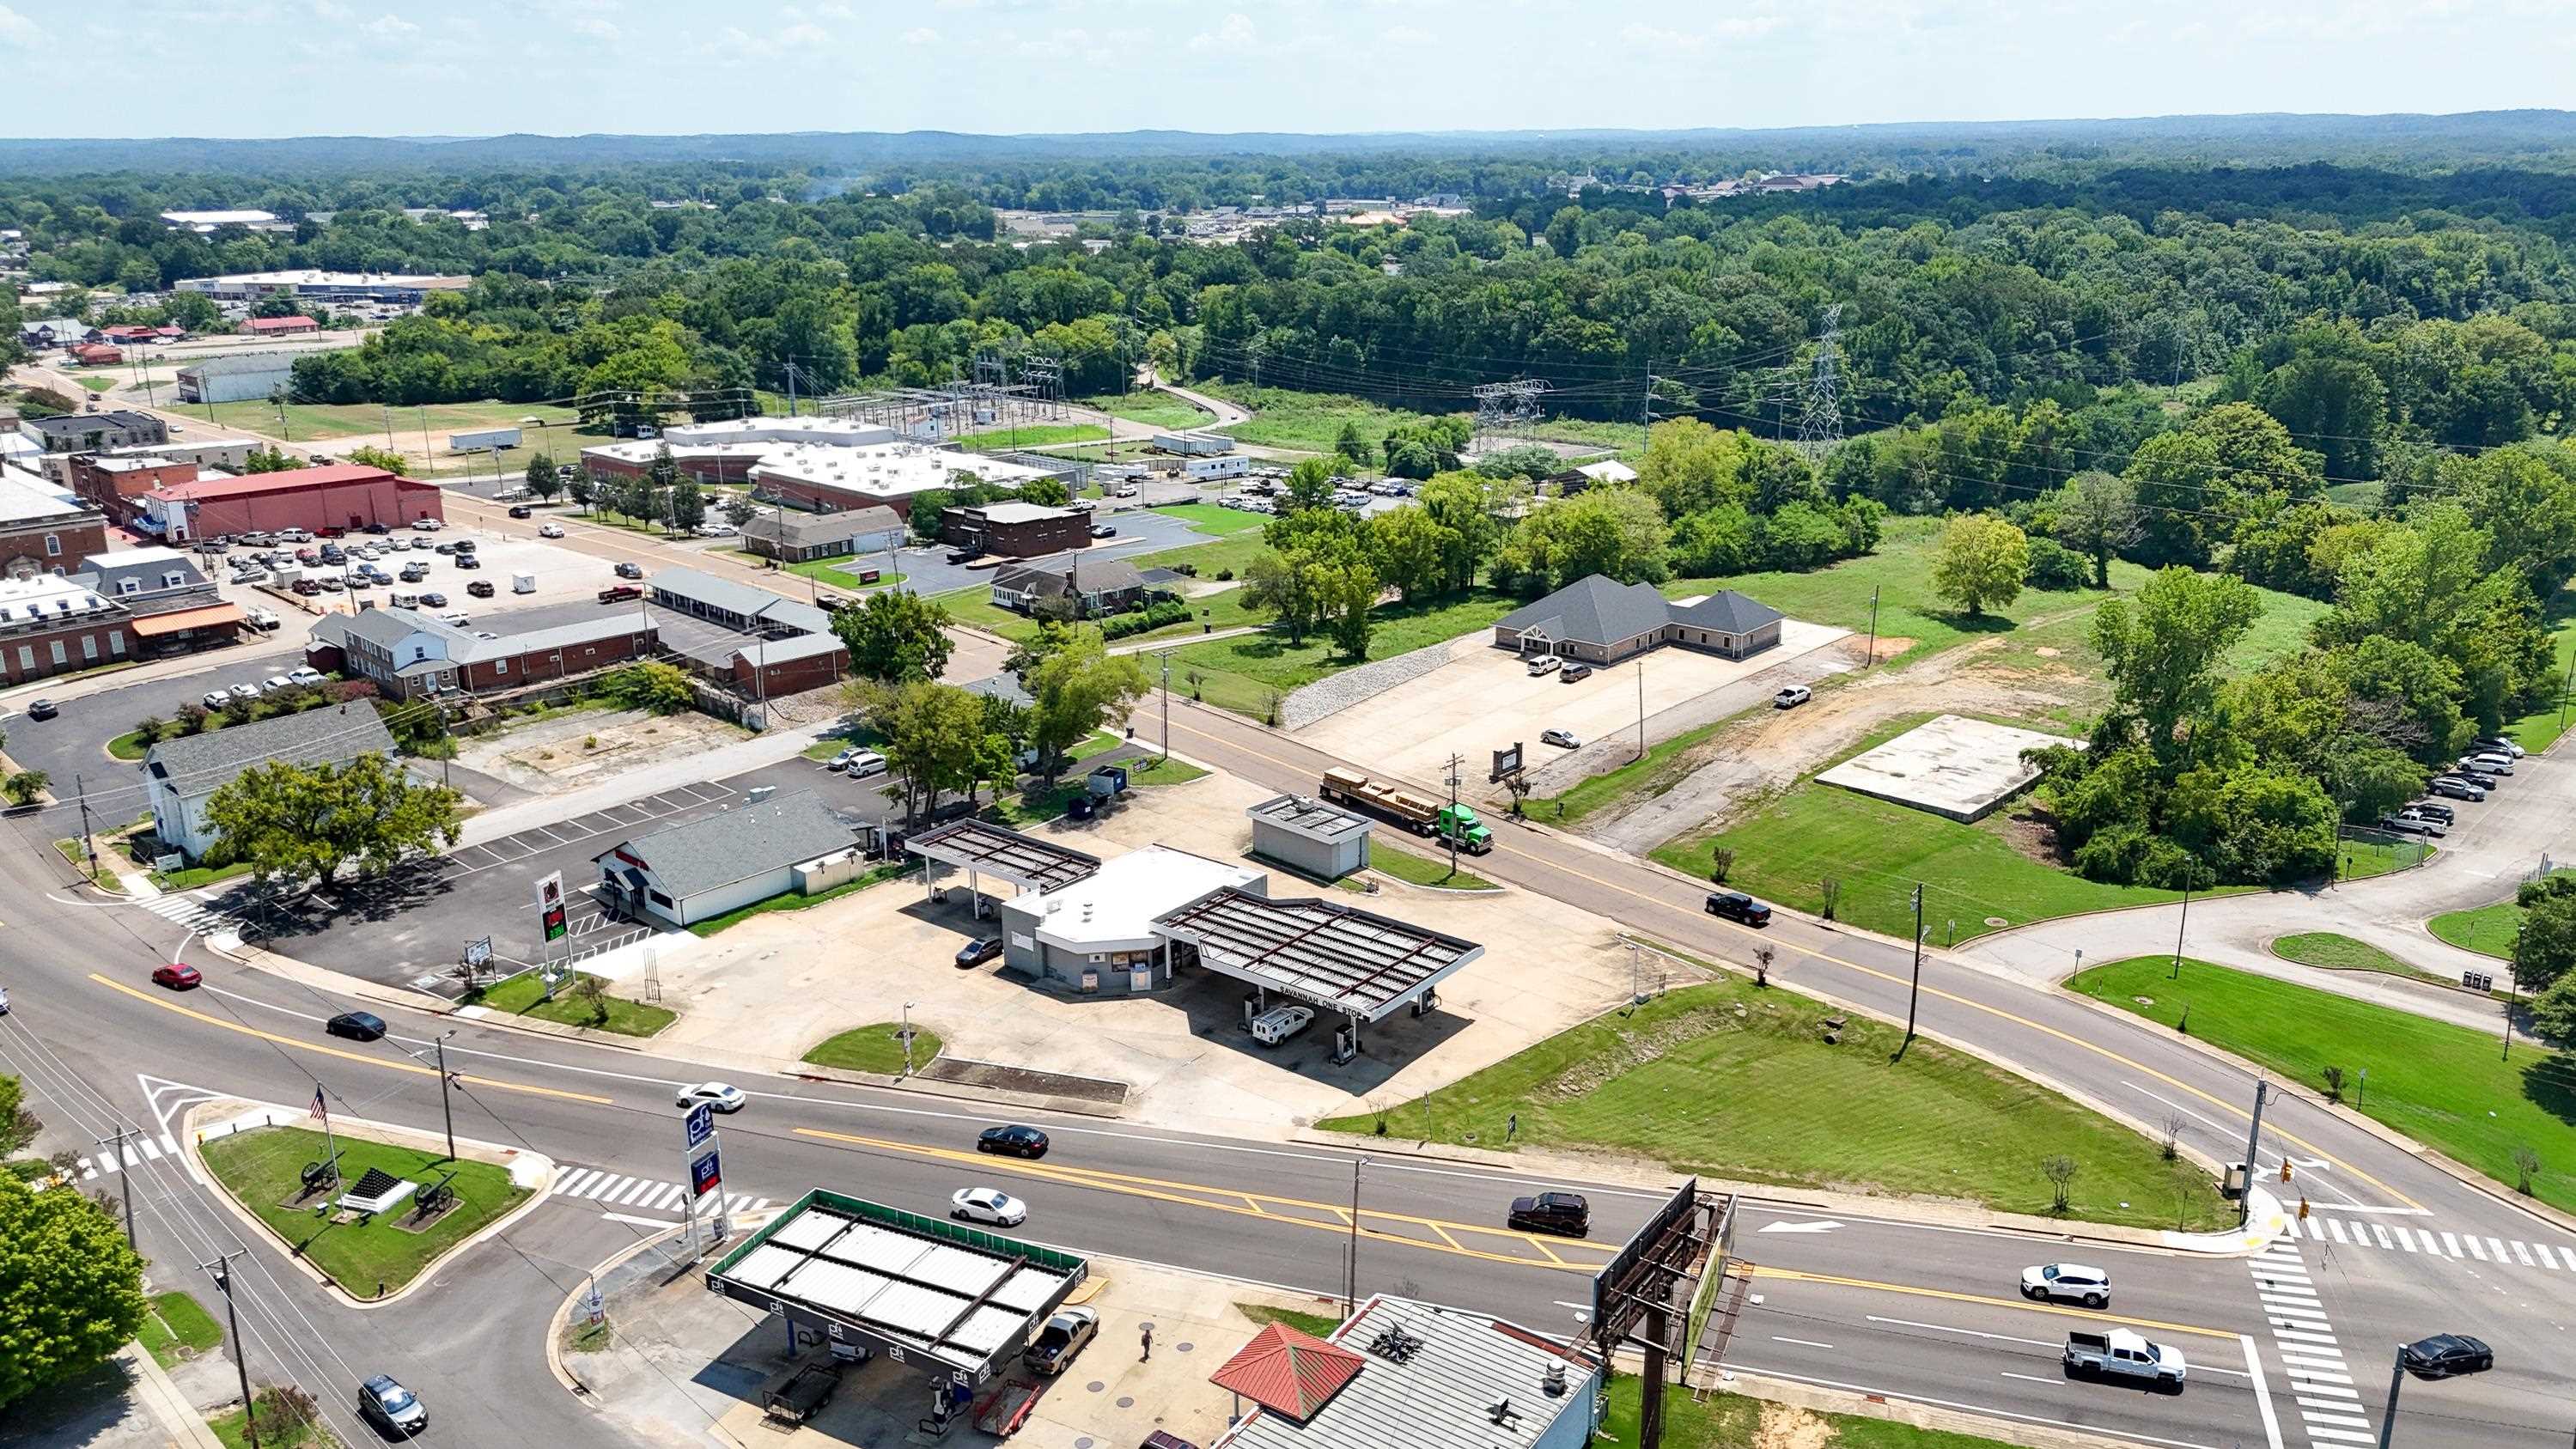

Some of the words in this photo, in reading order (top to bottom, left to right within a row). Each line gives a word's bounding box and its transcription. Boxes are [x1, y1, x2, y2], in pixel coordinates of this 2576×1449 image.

[1279, 986, 1318, 1005] SAVANNAH
[1323, 1001, 1337, 1011] ONE
[1342, 1007, 1362, 1018] STOP
